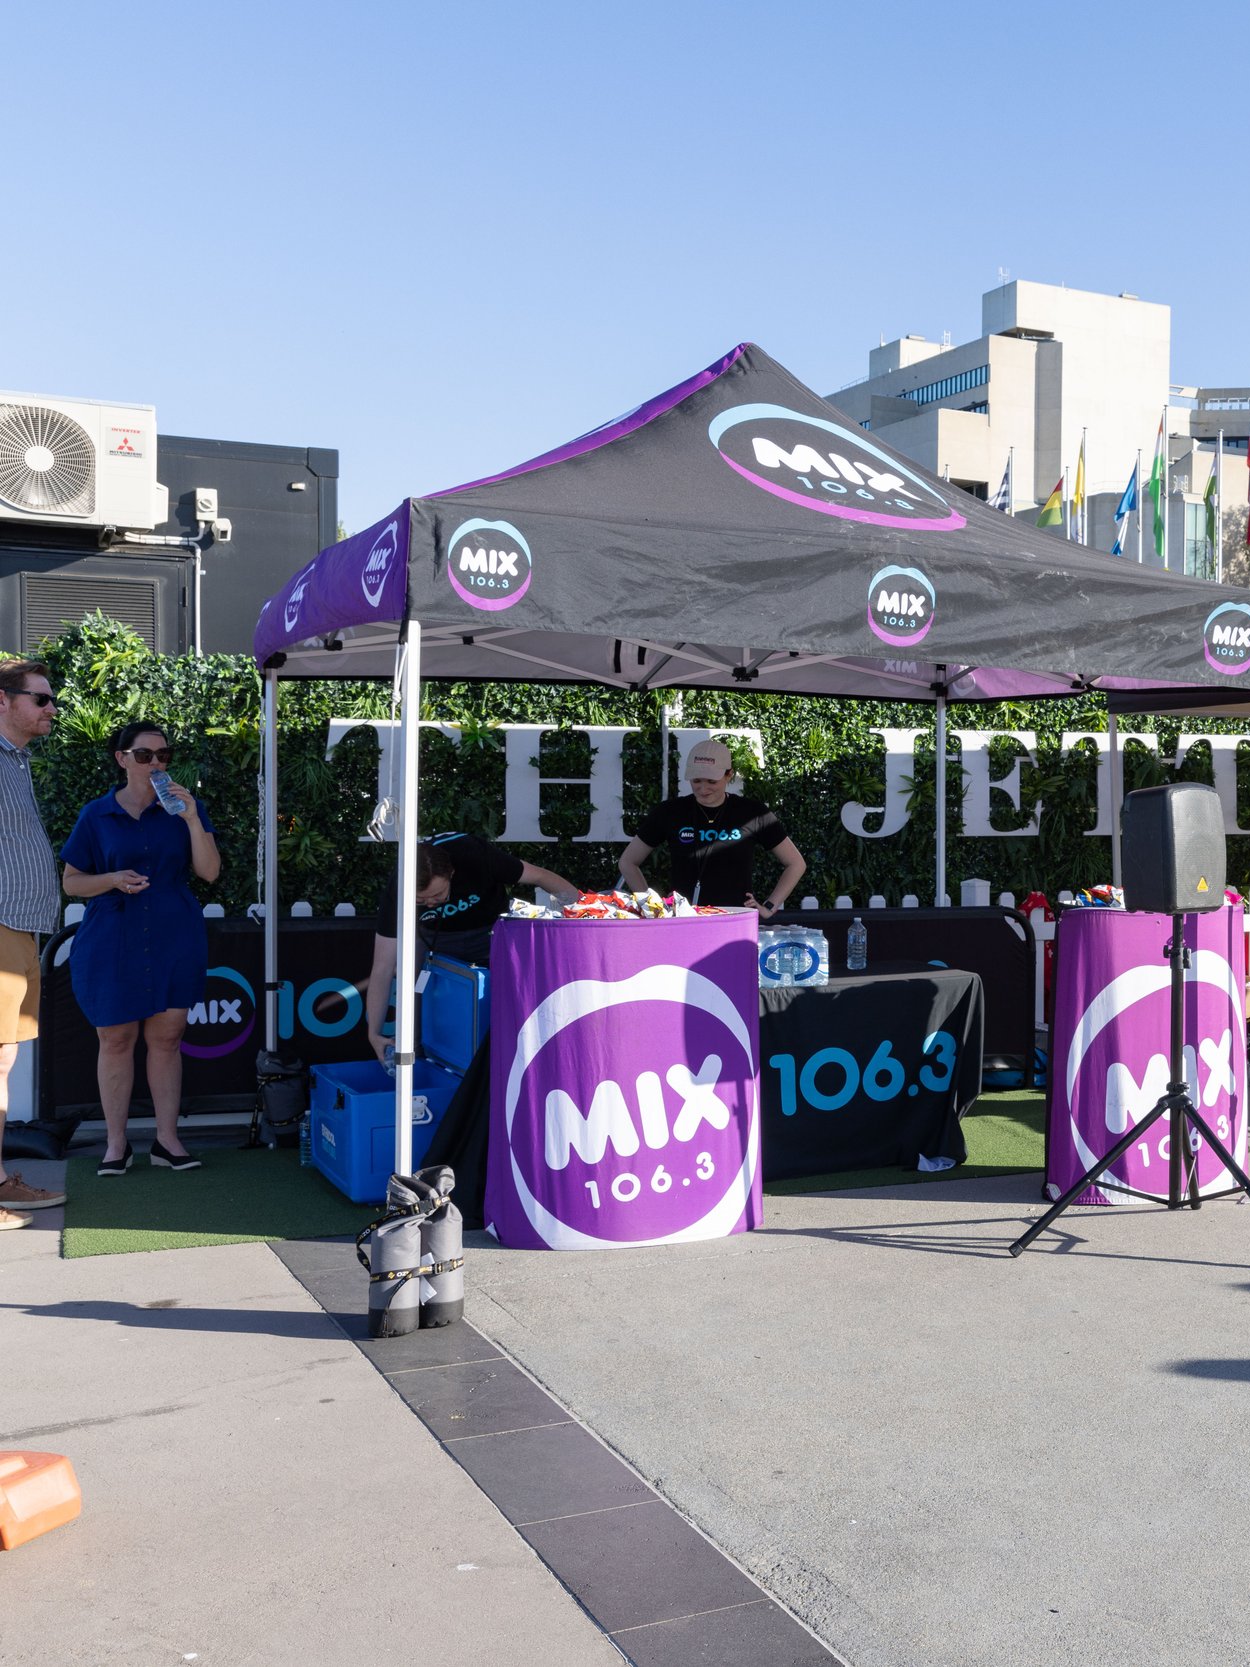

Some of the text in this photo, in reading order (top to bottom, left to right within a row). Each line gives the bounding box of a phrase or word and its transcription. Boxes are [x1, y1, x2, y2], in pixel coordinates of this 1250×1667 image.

[751, 437, 923, 501] MIX
[366, 547, 391, 572] MIX
[459, 546, 519, 577] MIX
[469, 575, 510, 589] 106.3
[876, 590, 926, 617] MIX
[883, 615, 916, 628] 106.3
[1216, 647, 1245, 658] 106.3
[699, 828, 742, 842] 106.3
[187, 998, 242, 1025] MIX
[769, 1030, 958, 1116] 106.3
[545, 1053, 731, 1171] MIX
[584, 1151, 716, 1209] 106.3
